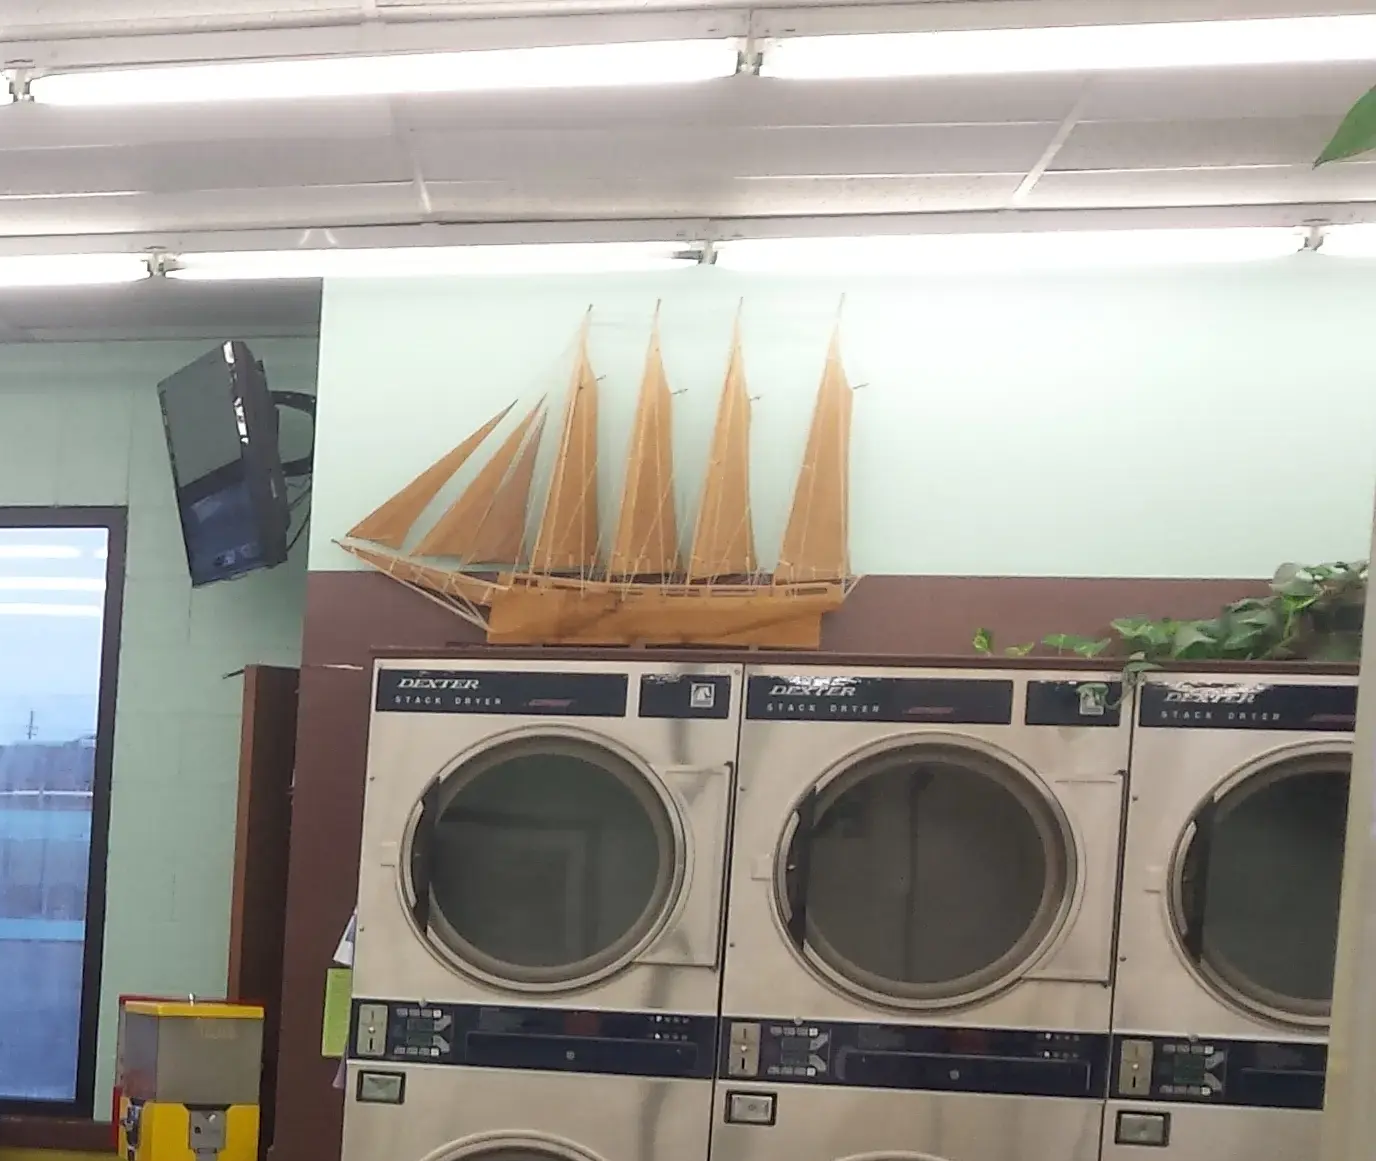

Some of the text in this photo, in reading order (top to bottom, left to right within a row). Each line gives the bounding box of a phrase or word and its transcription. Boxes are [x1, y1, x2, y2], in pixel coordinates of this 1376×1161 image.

[398, 678, 480, 690] DEXTER
[768, 685, 857, 697] DEXTER
[395, 695, 502, 706] STACK DRYER
[766, 702, 816, 712] STACK
